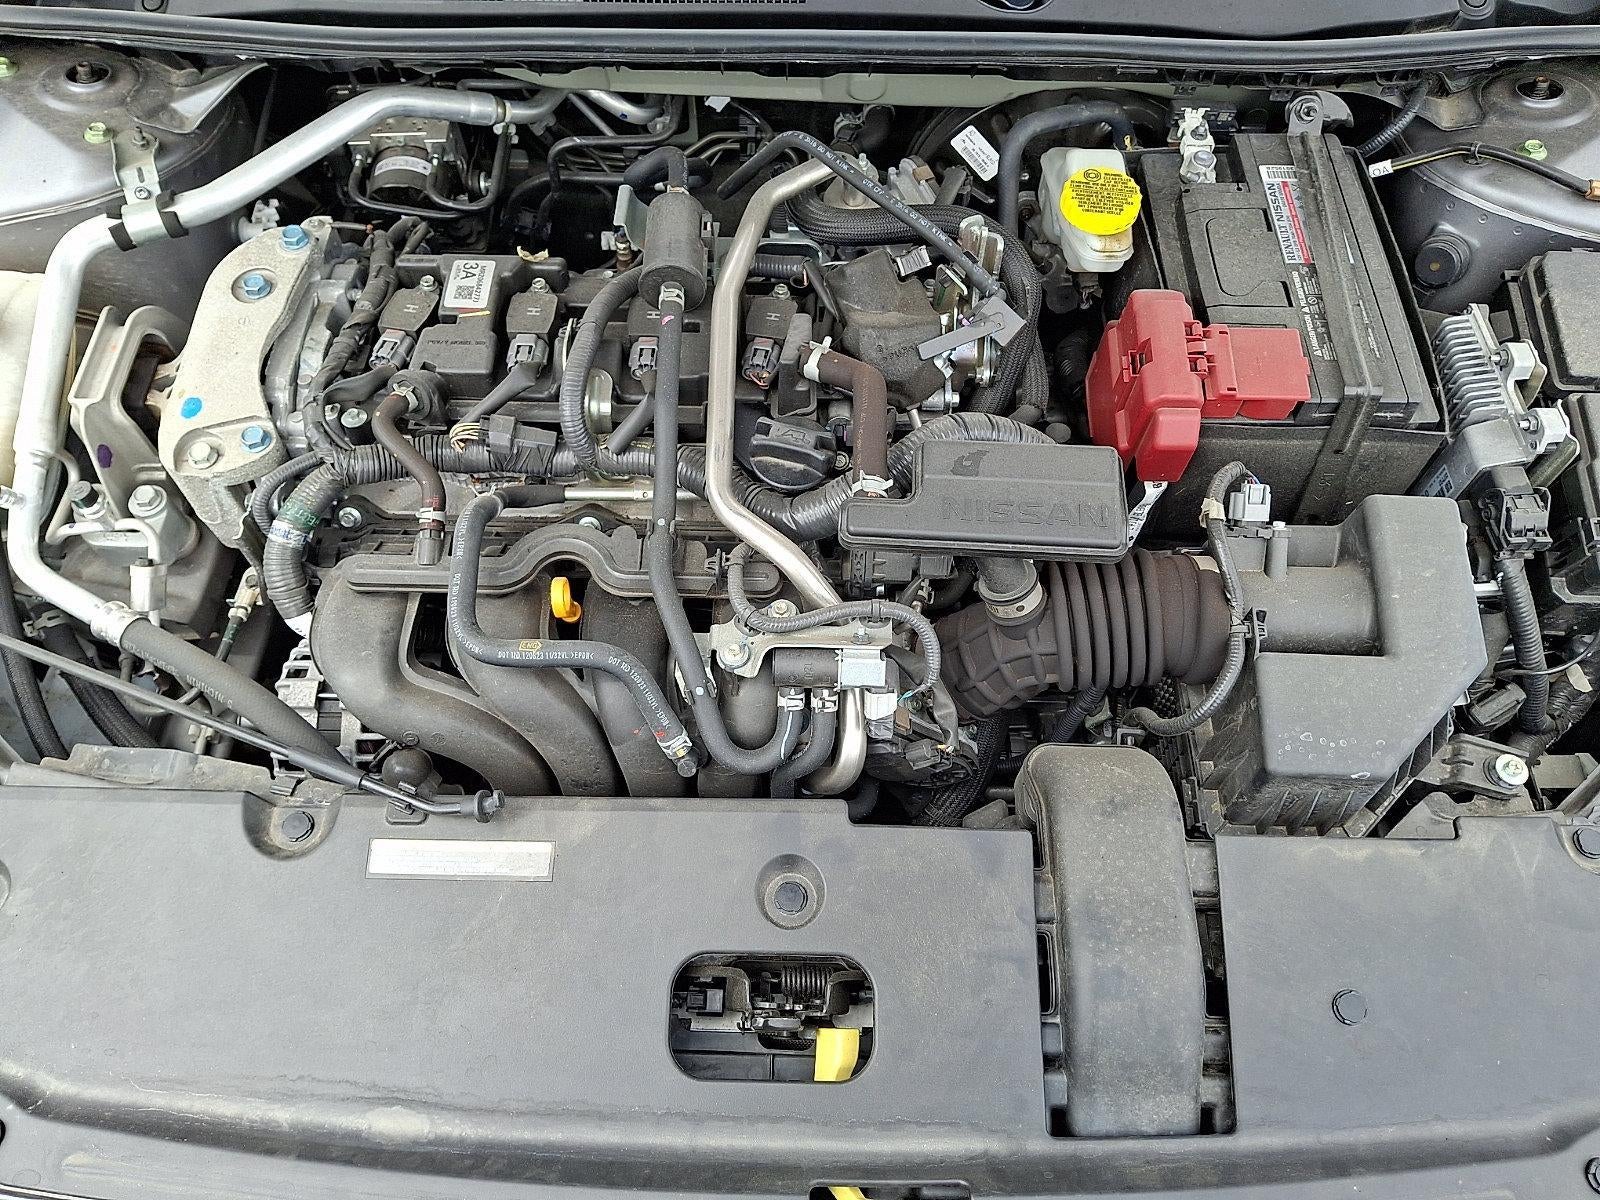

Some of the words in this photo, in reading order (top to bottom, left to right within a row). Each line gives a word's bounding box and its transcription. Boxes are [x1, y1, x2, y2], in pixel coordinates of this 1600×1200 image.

[1264, 181, 1285, 223] NISSAN
[930, 226, 948, 242] KINK
[1276, 222, 1297, 263] RENAULT
[459, 260, 479, 282] 3A
[941, 496, 1108, 527] NISSAN
